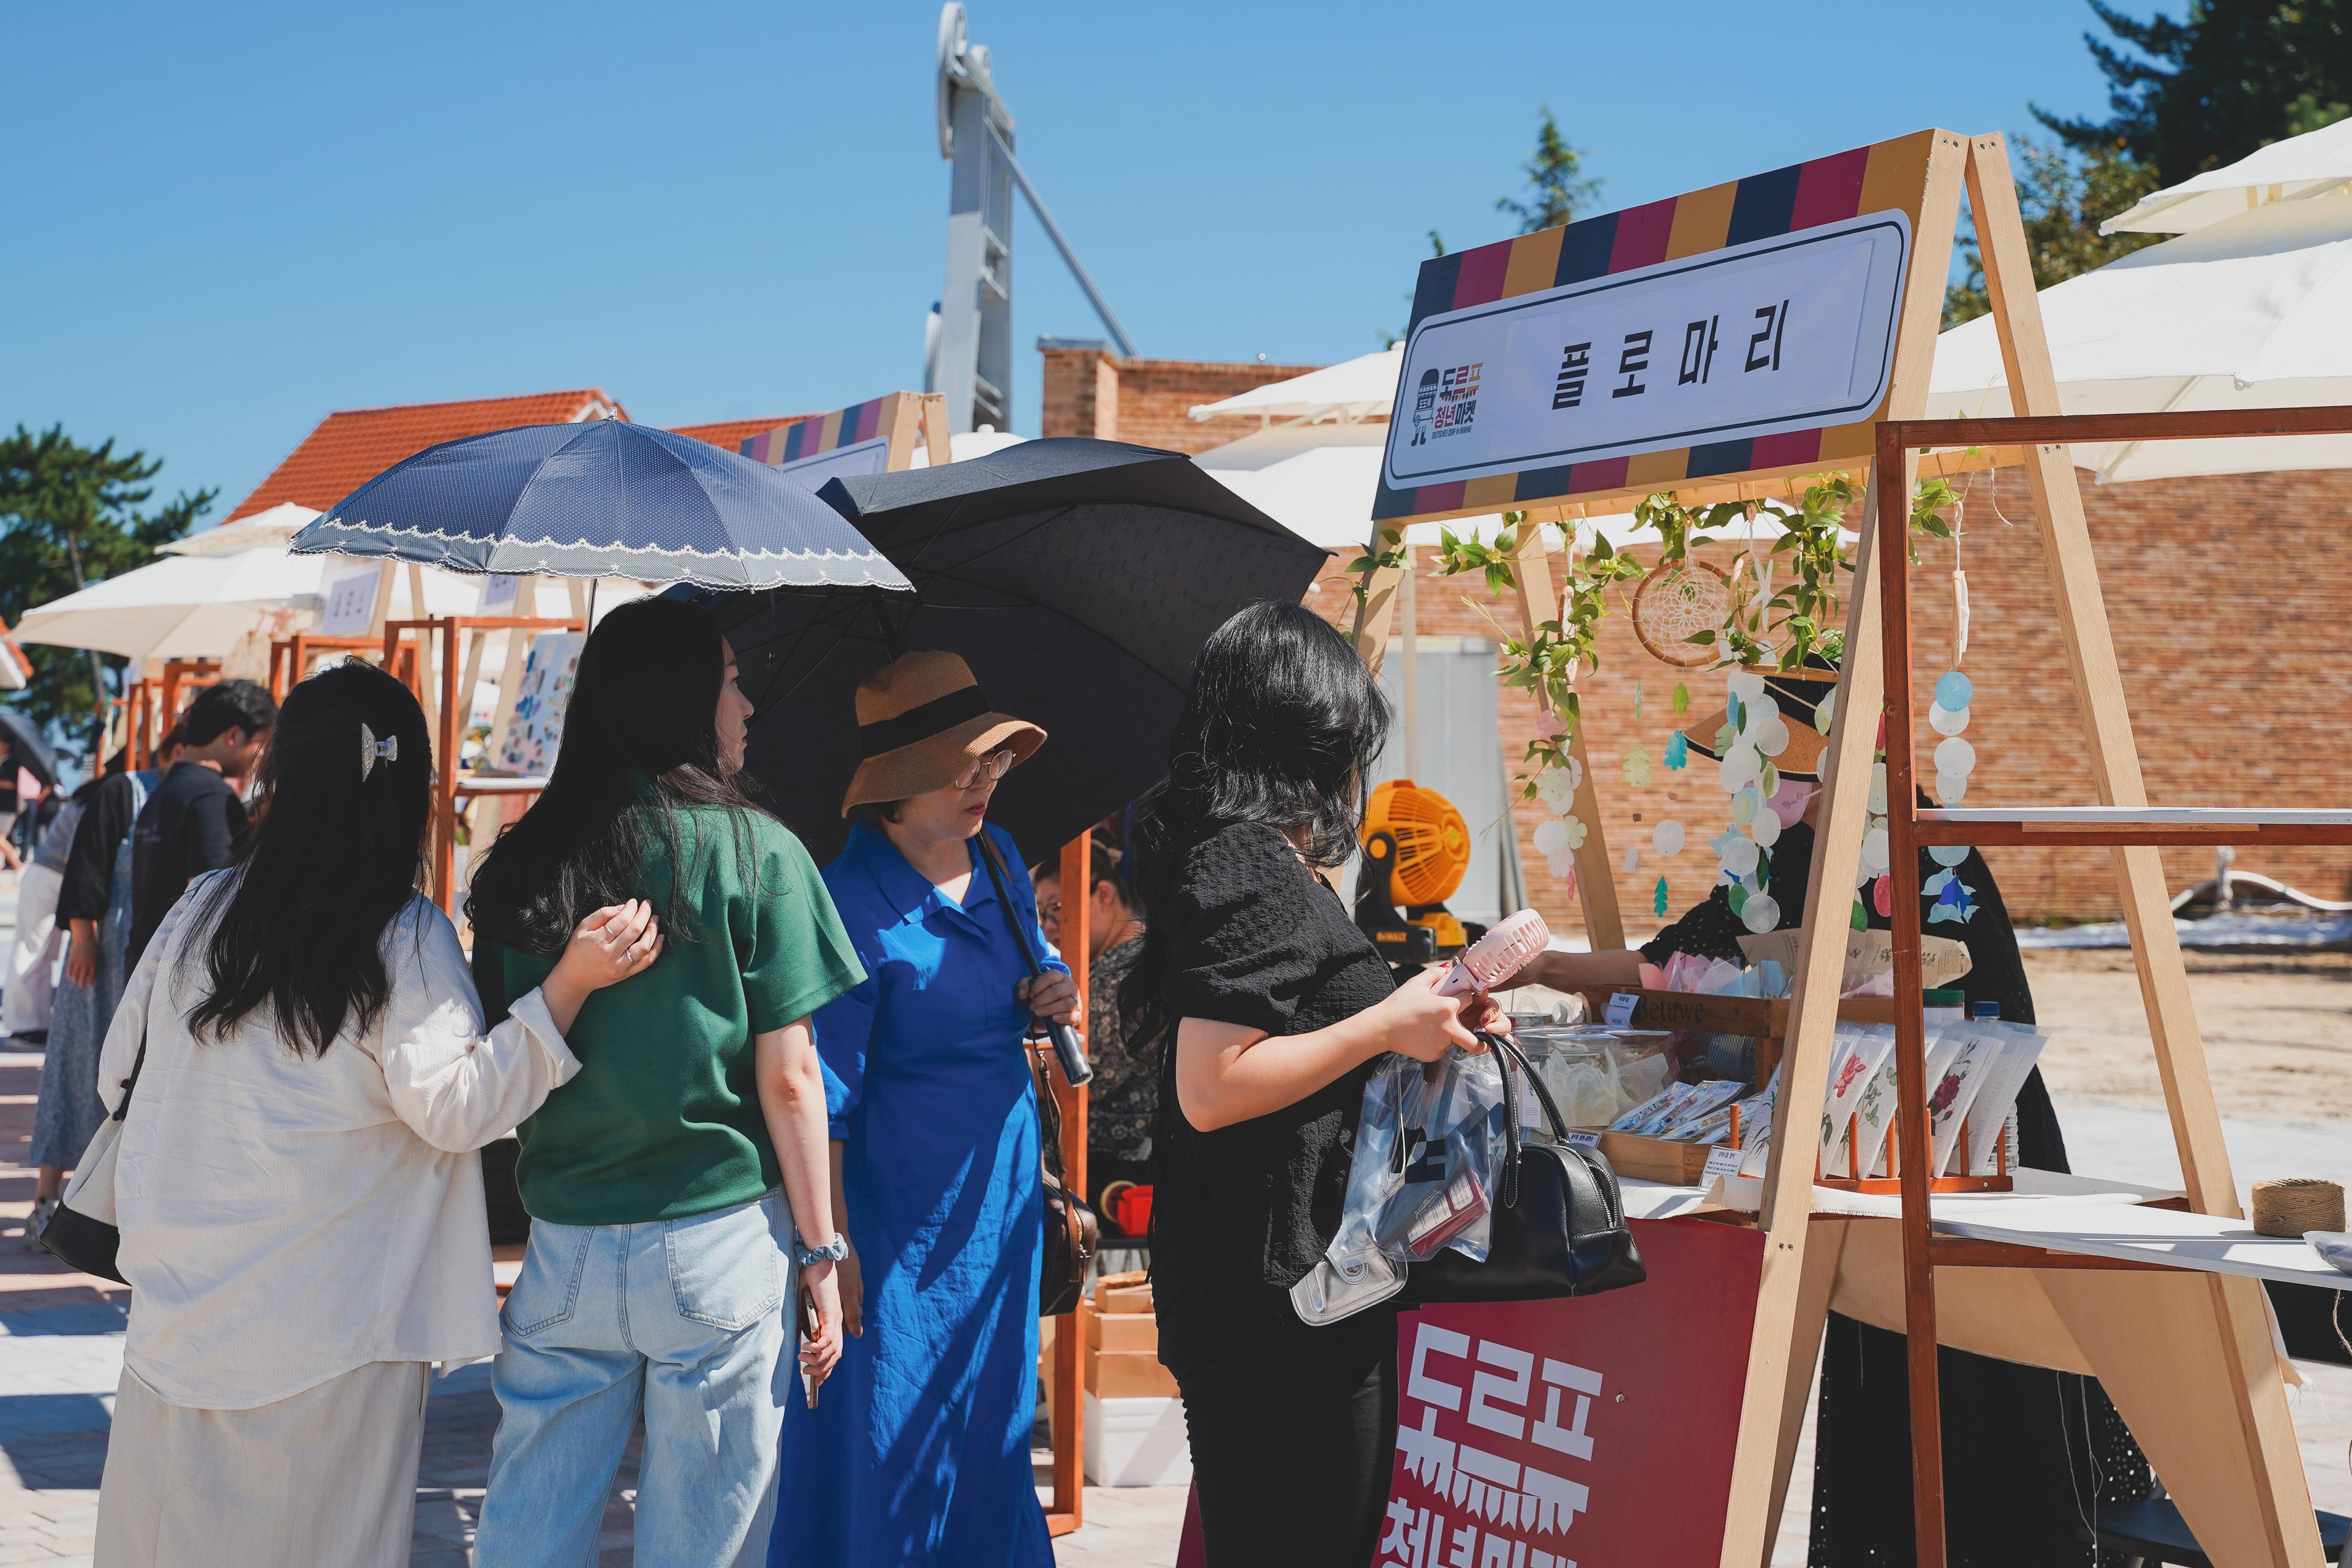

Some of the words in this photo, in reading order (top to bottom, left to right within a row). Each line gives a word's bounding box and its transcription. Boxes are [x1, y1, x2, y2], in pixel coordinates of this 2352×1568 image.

[1551, 299, 1790, 410] 플로마리
[1439, 363, 1483, 402] 도르프
[1434, 400, 1477, 429] 청년마켓
